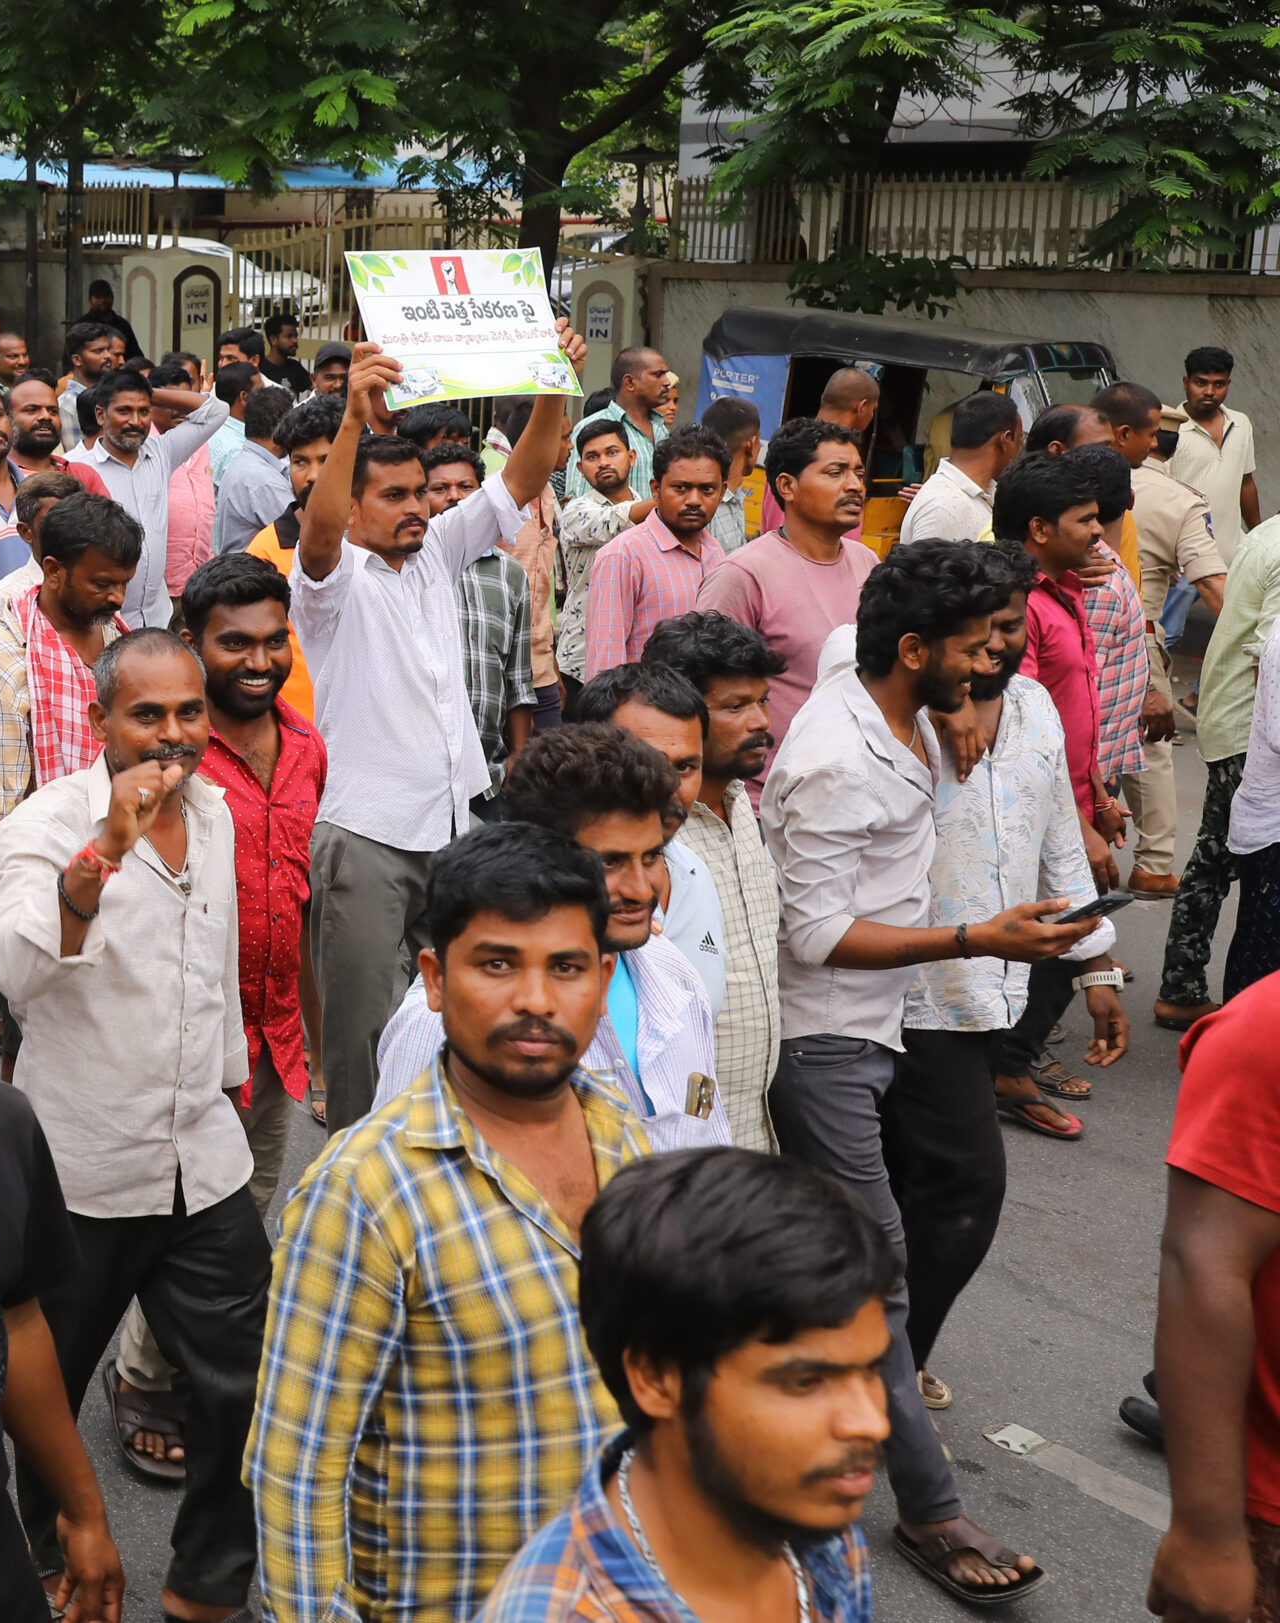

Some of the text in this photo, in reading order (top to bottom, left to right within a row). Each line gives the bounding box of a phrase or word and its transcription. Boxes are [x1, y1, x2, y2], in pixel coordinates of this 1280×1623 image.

[401, 299, 440, 322] ఇంటి
[469, 298, 518, 320] సేకరణ
[187, 313, 207, 325] IN
[589, 328, 608, 338] IN
[699, 944, 719, 955] adidas
